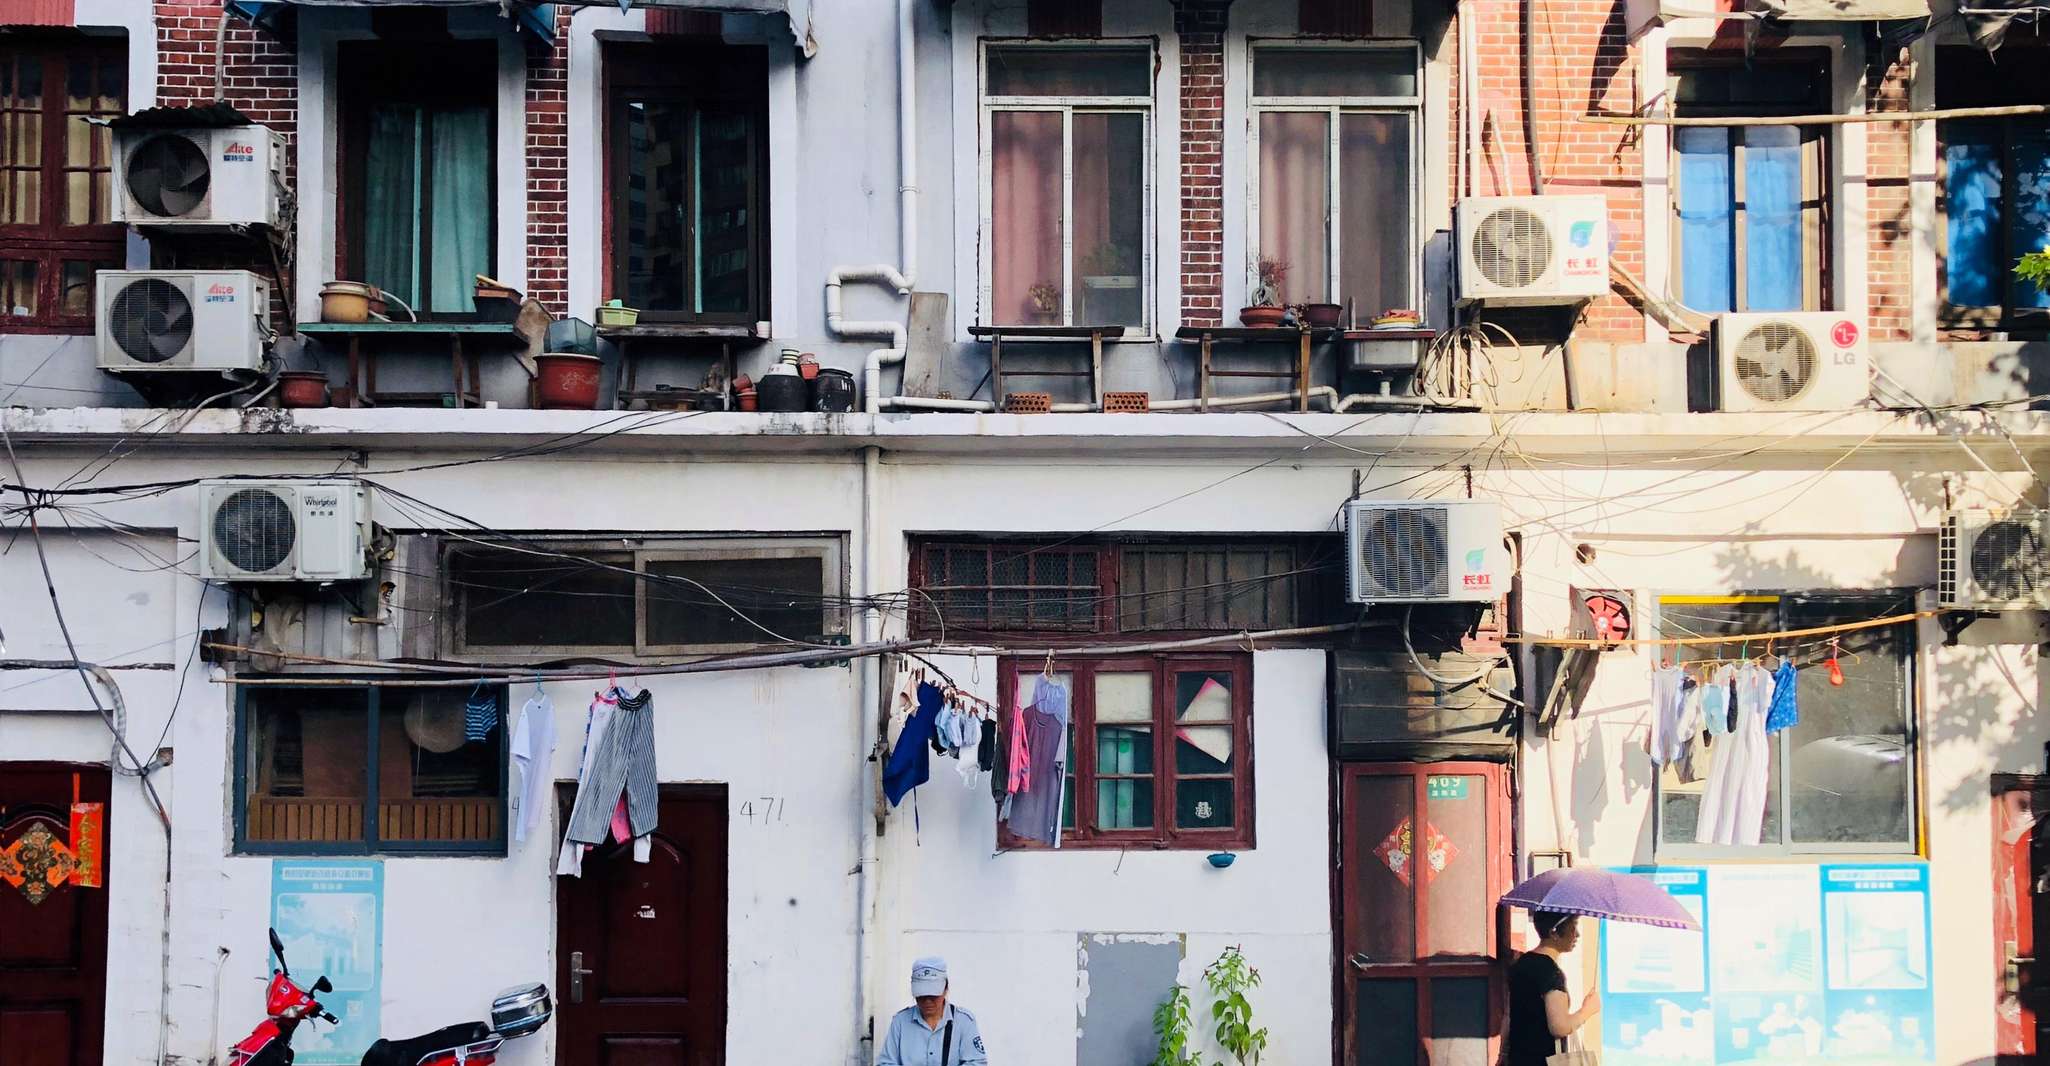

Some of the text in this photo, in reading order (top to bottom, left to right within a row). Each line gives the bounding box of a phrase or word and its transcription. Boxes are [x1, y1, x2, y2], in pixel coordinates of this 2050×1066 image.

[1833, 352, 1856, 365] LG
[1463, 575, 1491, 585] 长虹
[740, 797, 785, 825] 471
